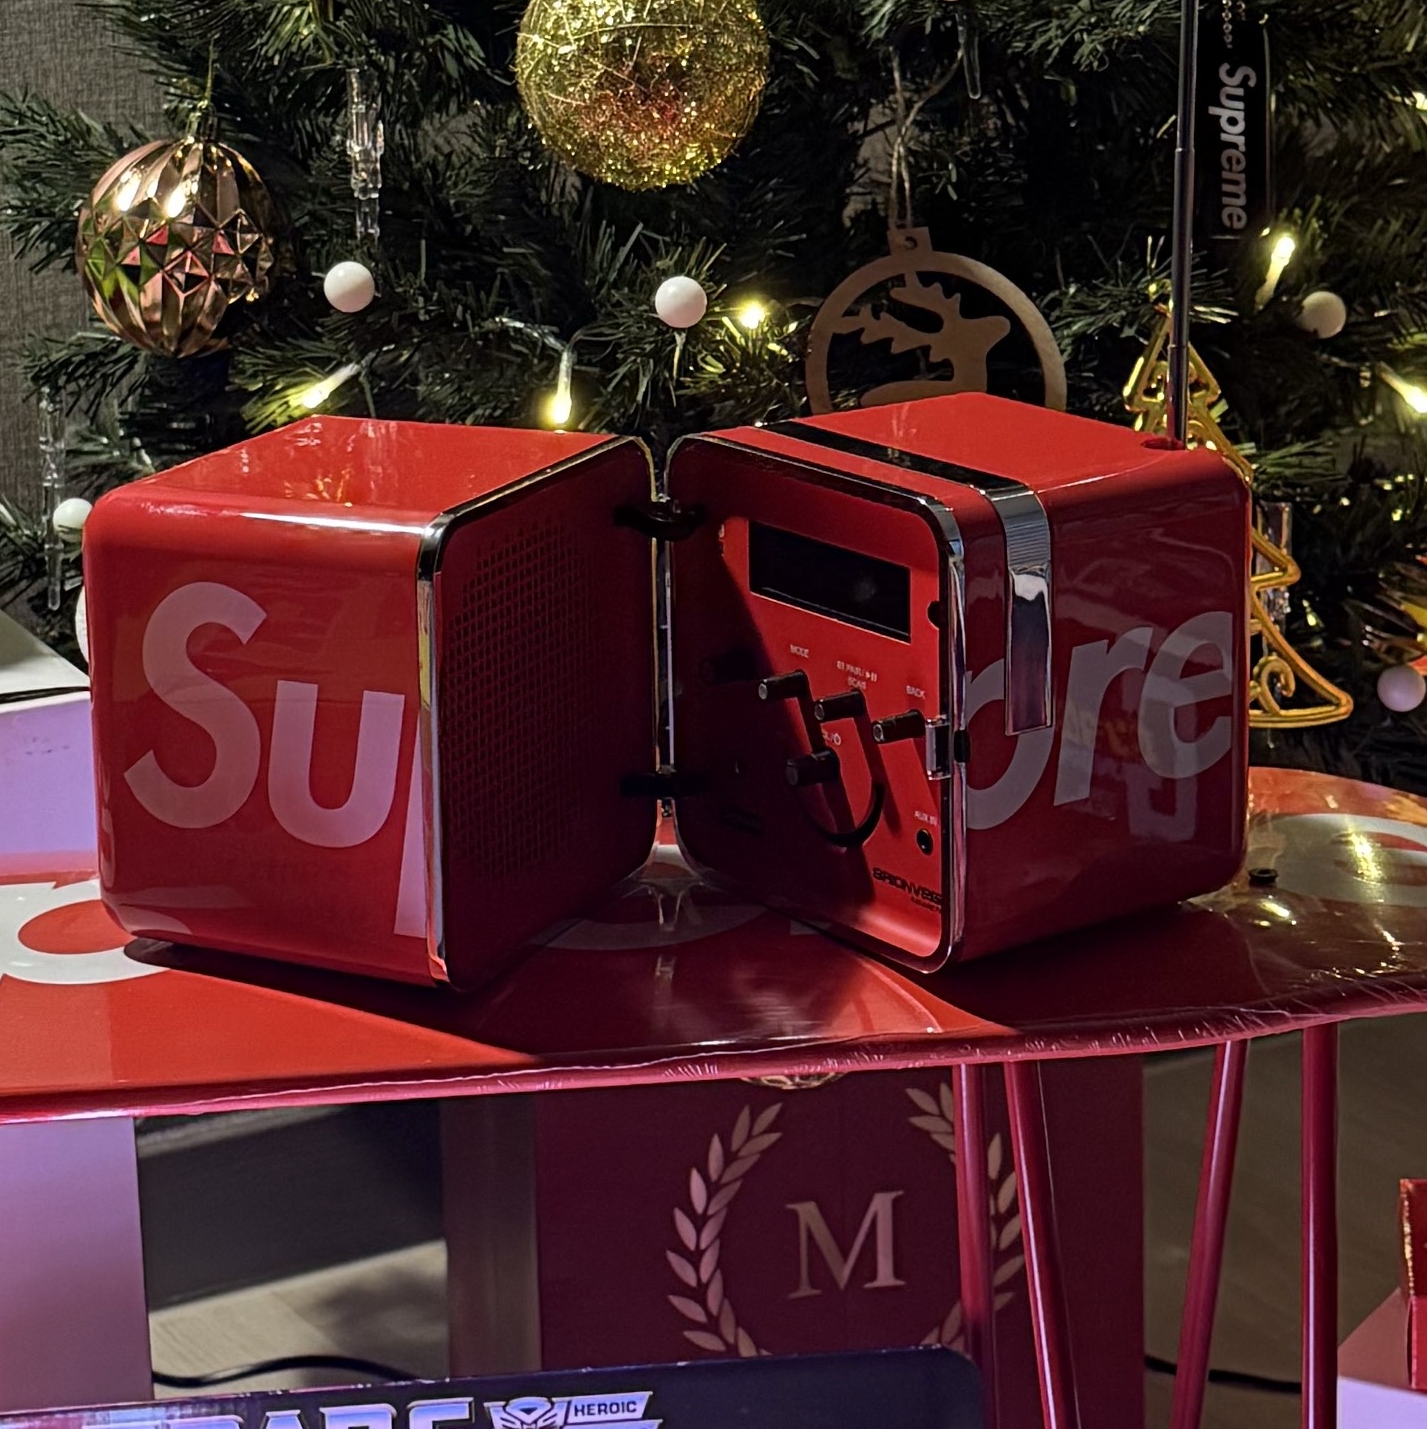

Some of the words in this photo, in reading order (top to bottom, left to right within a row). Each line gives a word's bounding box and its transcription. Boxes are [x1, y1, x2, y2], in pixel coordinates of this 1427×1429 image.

[1208, 63, 1256, 230] Supreme
[787, 1191, 909, 1300] M
[573, 1400, 638, 1417] HEROIC
